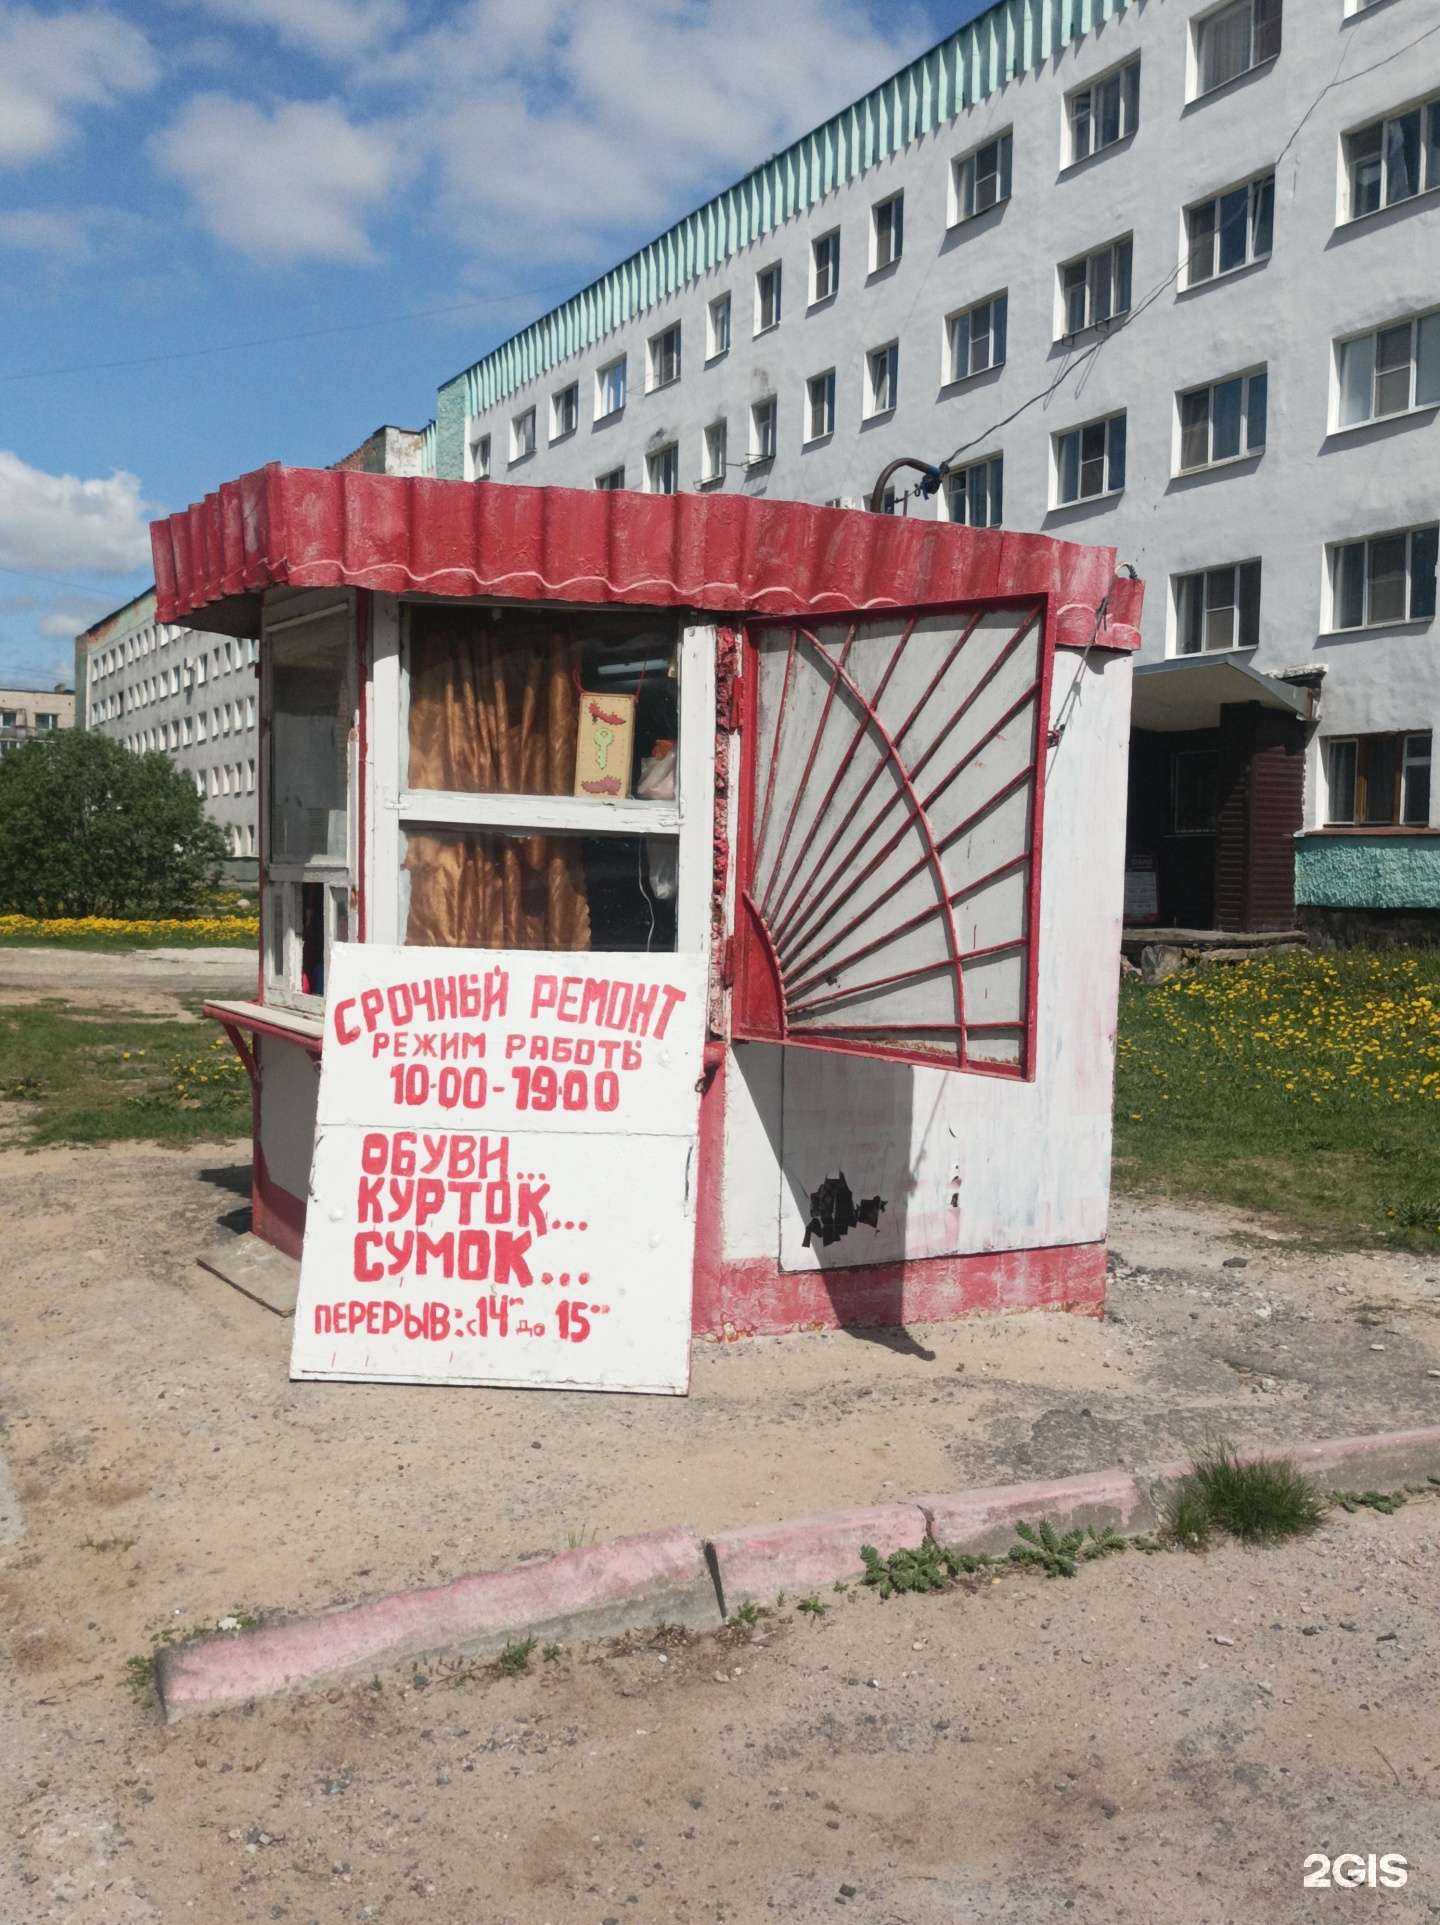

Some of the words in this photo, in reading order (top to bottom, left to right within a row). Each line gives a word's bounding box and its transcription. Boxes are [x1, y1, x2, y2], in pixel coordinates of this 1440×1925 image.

[333, 965, 510, 1046] СРОЧНЫЙ
[530, 975, 687, 1041] РЕМОНТ
[372, 1032, 487, 1060] РЕЖИМ
